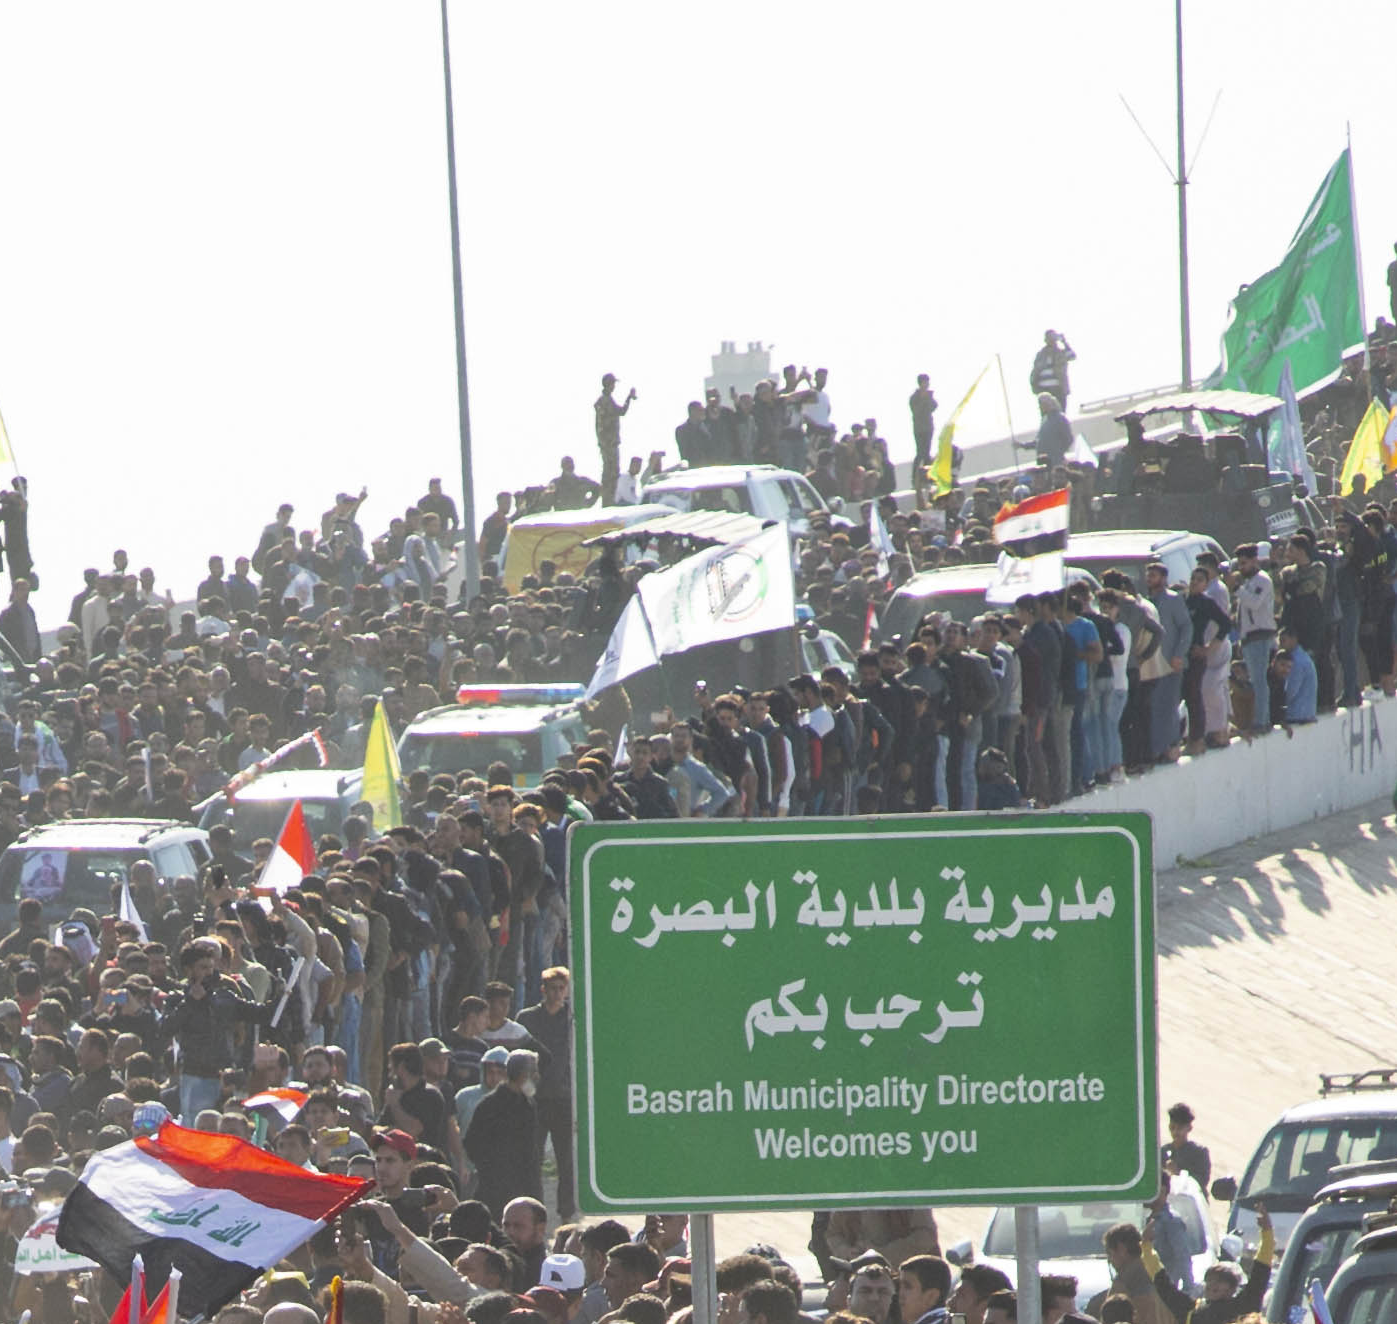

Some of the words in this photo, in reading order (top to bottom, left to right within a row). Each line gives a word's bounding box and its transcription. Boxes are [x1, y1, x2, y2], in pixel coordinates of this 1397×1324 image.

[609, 877, 777, 948] البصرة
[793, 870, 925, 946] بلدية
[941, 866, 1116, 942] مديرية
[744, 978, 828, 1051] بكم
[844, 971, 984, 1046] ترحب
[628, 1082, 733, 1115] Basrah
[744, 1076, 927, 1117] Municipality
[938, 1072, 1105, 1105] Directorate
[754, 1127, 912, 1160] Welcomes
[921, 1130, 978, 1163] you
